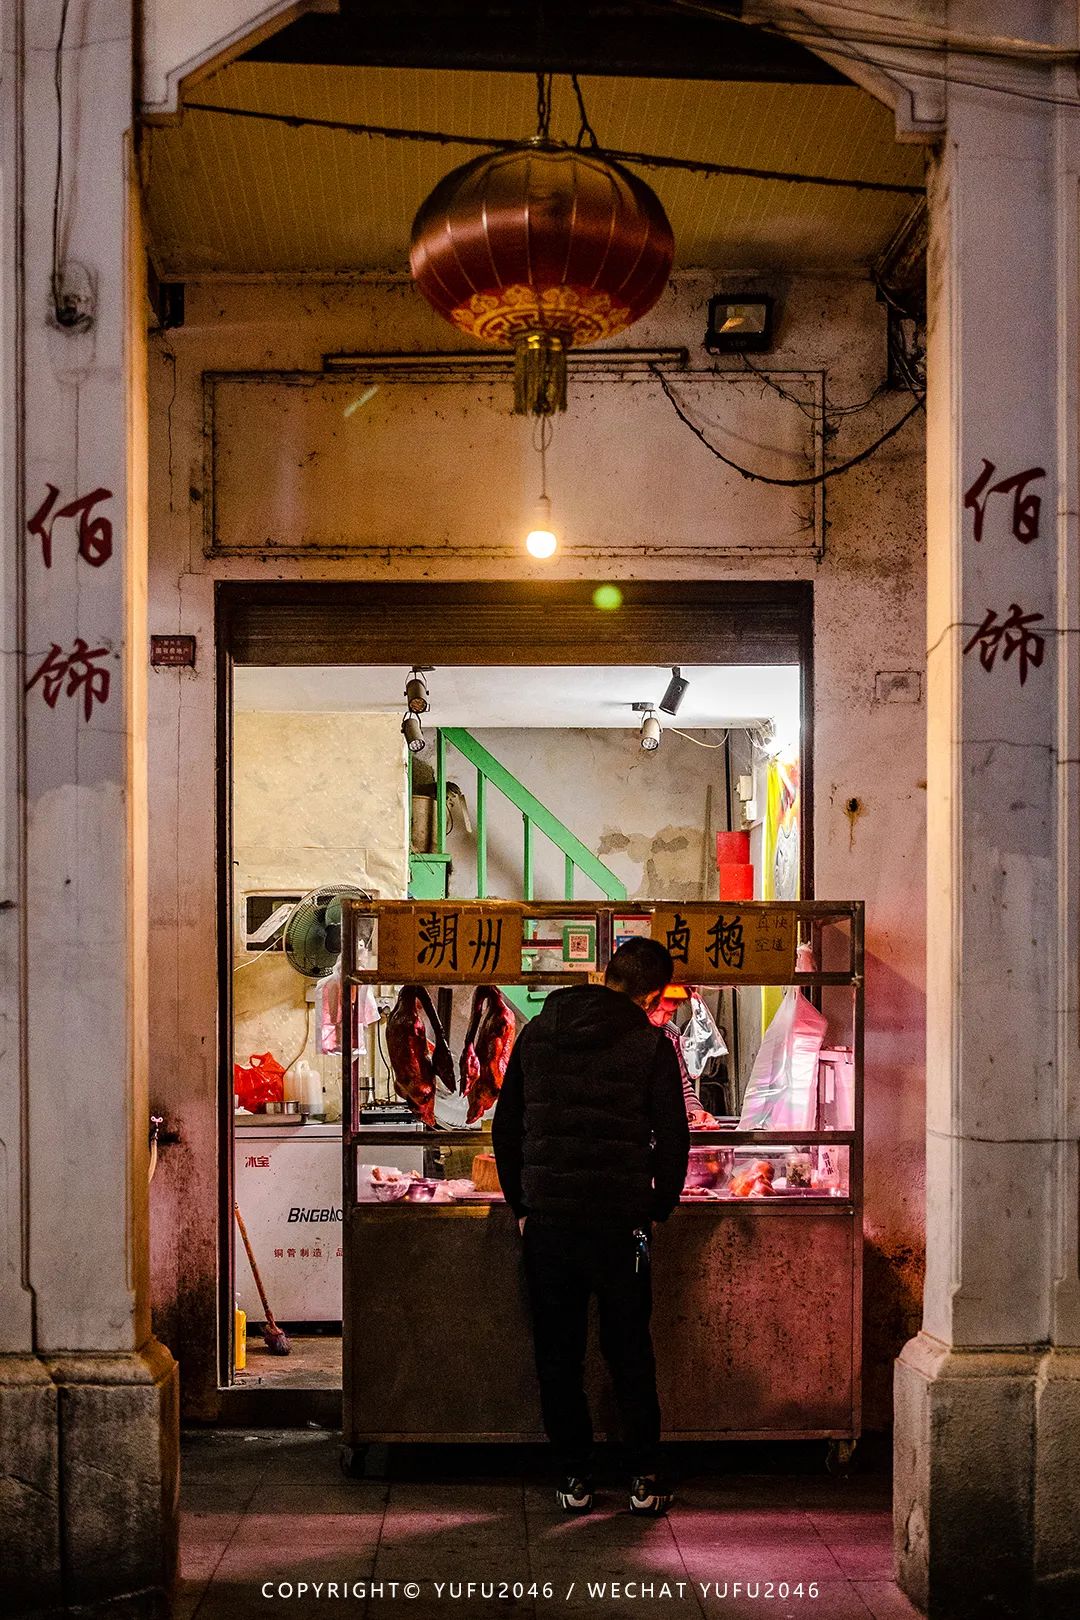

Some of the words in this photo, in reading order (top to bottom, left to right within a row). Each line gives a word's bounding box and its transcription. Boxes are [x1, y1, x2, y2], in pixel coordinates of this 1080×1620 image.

[417, 911, 503, 974] 潮州
[666, 913, 745, 970] 卤鹅
[245, 1156, 270, 1168] 冰宝
